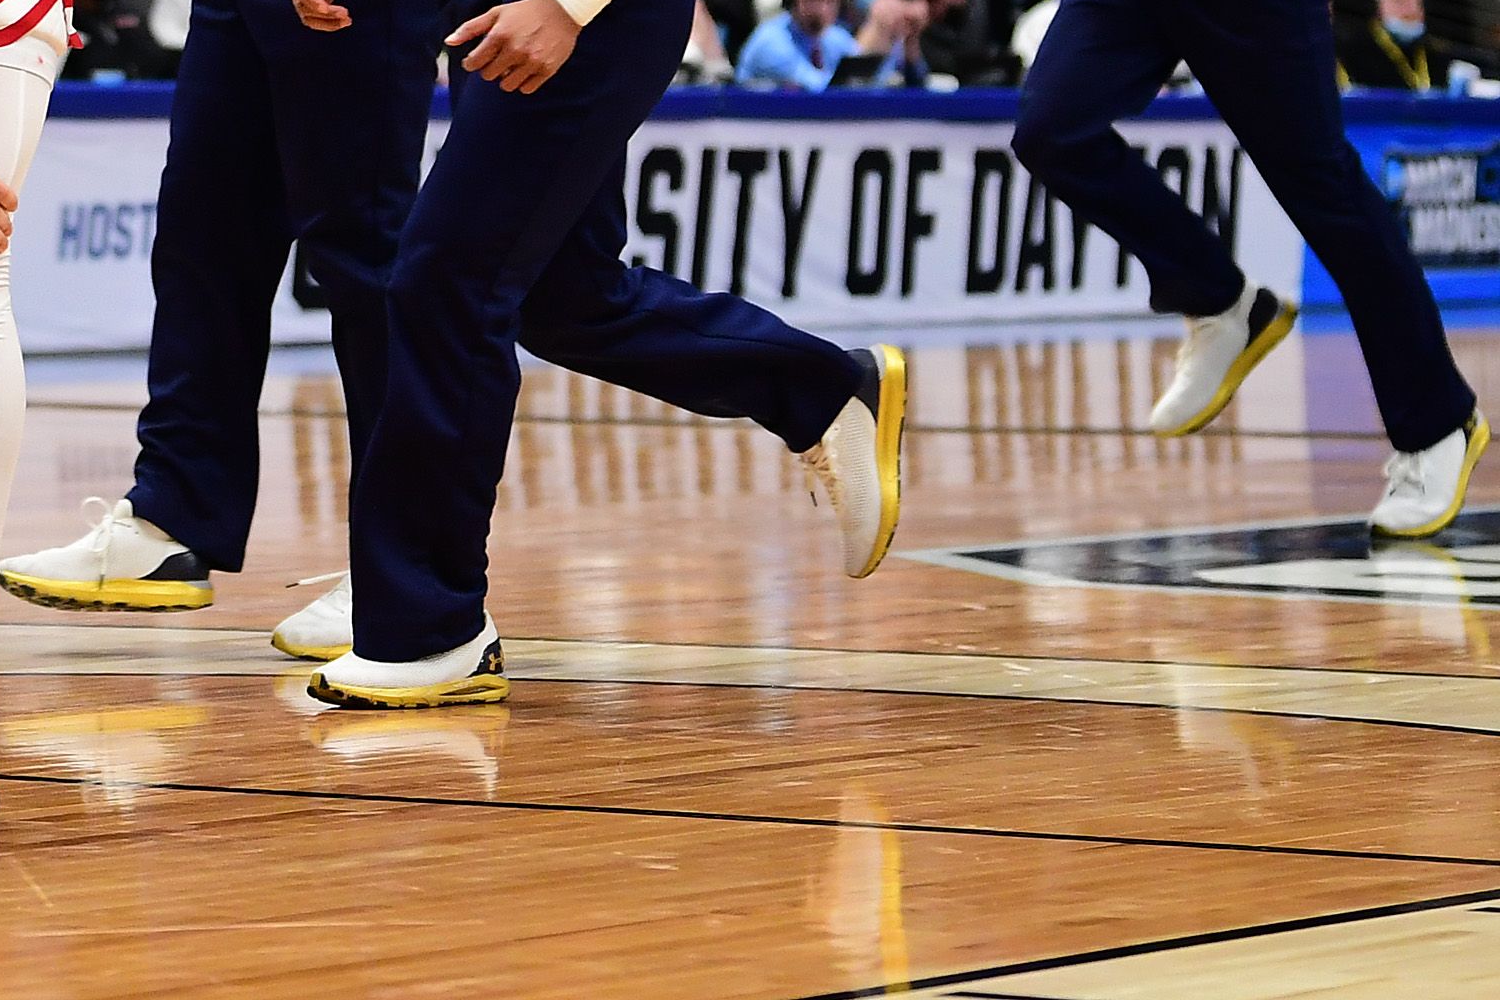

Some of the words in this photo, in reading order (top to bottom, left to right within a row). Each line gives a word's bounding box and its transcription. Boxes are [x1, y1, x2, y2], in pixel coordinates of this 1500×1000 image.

[631, 147, 822, 299] SITY
[845, 147, 943, 298] OF
[966, 147, 1246, 296] DAN
